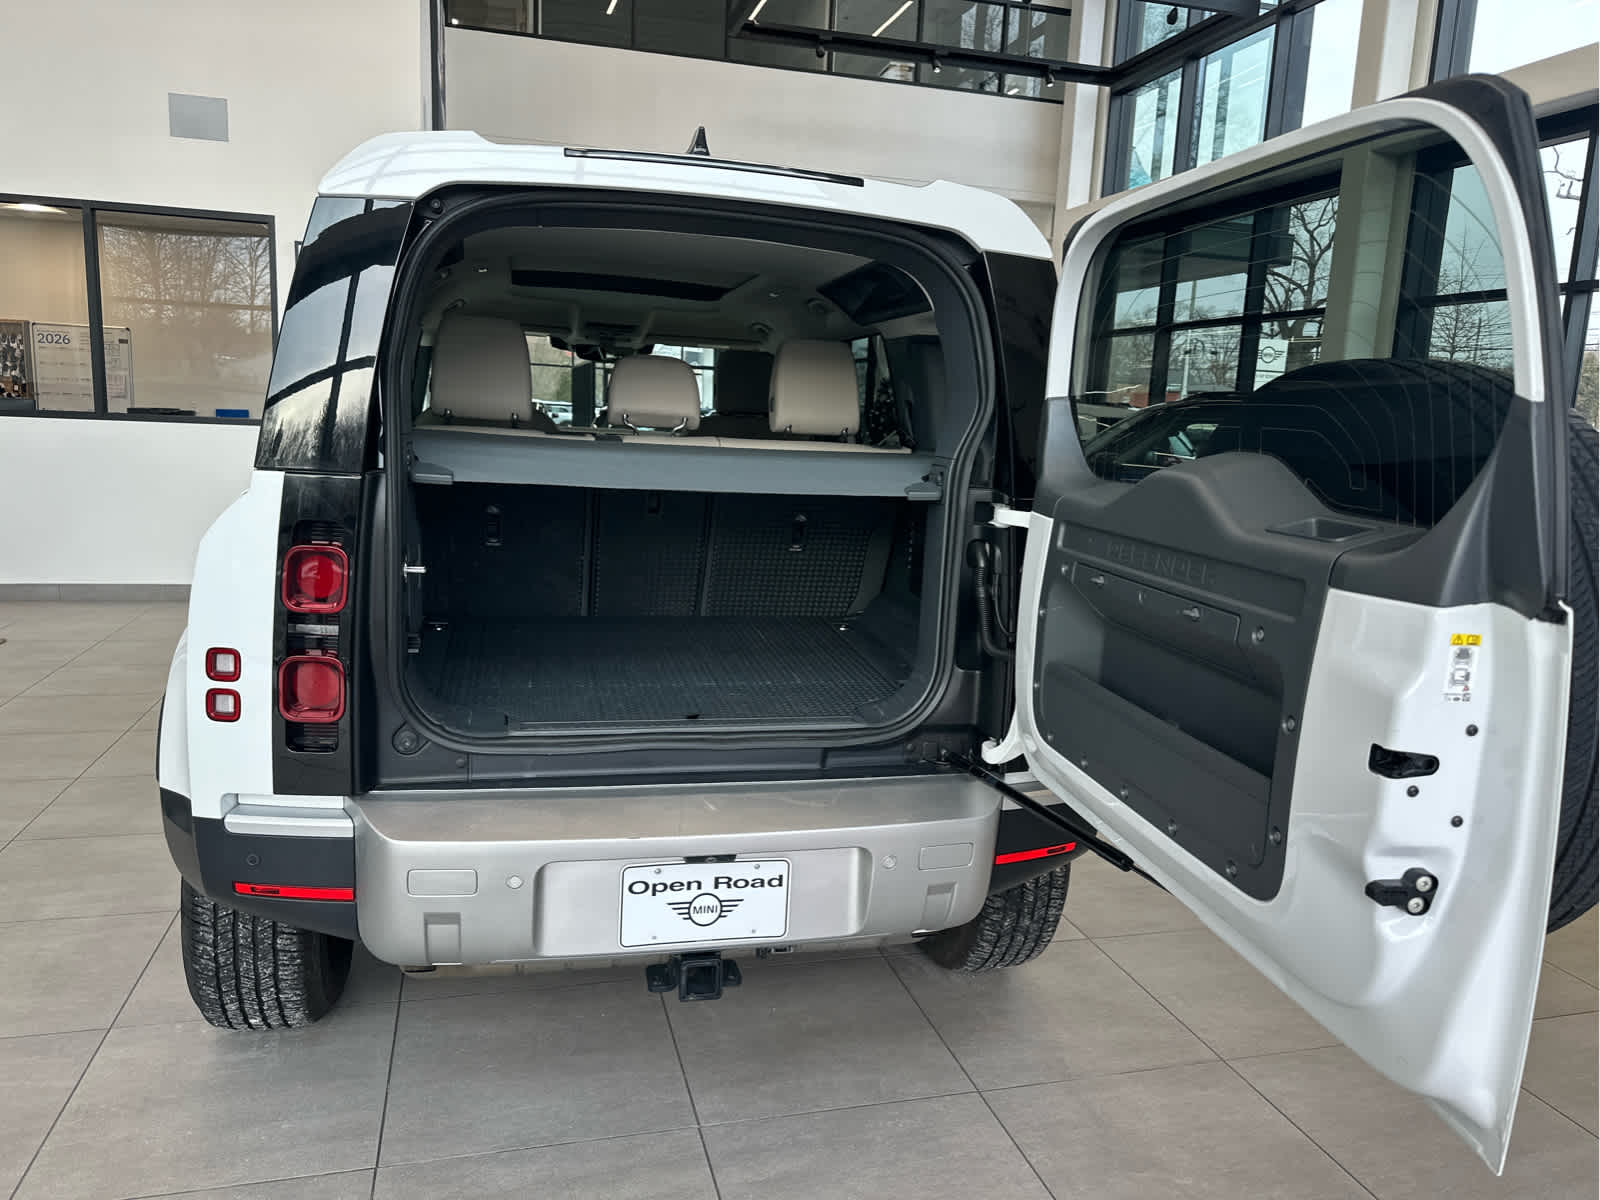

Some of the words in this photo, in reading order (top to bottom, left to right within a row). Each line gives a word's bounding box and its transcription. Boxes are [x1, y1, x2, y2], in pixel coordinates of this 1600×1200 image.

[37, 333, 71, 344] 2026
[628, 879, 702, 897] Open
[713, 874, 784, 890] Road
[692, 904, 719, 915] MINI
